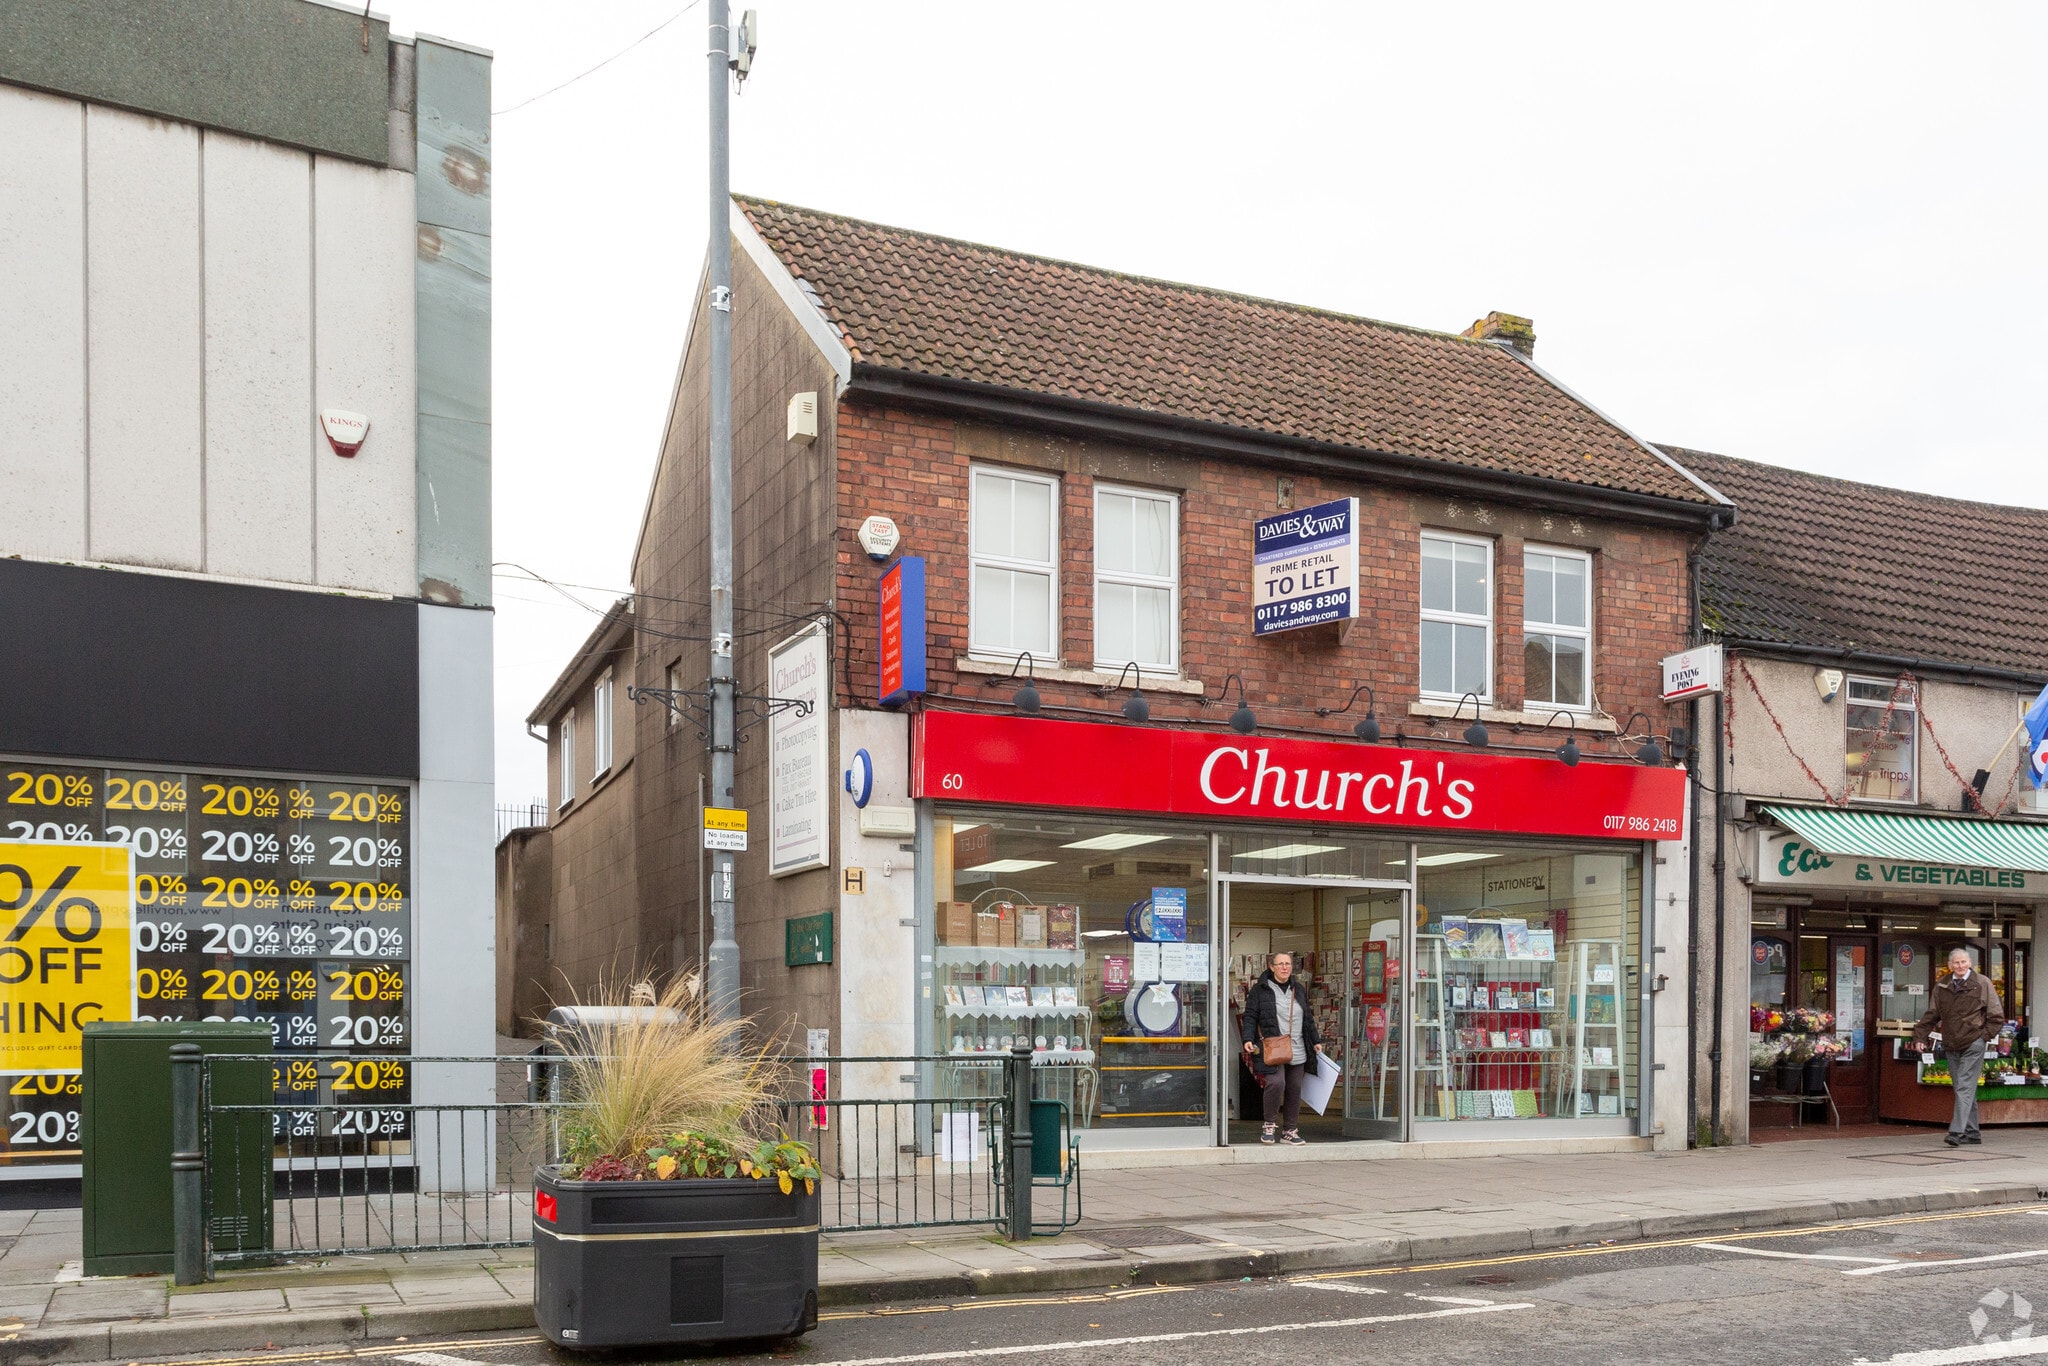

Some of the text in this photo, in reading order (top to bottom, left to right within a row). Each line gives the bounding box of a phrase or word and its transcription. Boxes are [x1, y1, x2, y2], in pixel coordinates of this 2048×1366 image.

[330, 417, 362, 427] KINGS
[1259, 538, 1346, 561] CHARTERED SURVEYORS ESTATE AGENTS
[1270, 554, 1334, 575] PRIME RETAIL
[1265, 566, 1339, 598] TO LET
[1257, 592, 1347, 620] 0117 986 8300
[1264, 610, 1338, 631] daviesandway.com
[776, 652, 817, 693] Church's
[1671, 667, 1699, 683] EVENING
[1677, 679, 1693, 690] POST
[781, 724, 817, 751] Photocopying
[781, 753, 812, 776] Fax Bureau
[1880, 768, 1908, 782] Tripps
[7, 772, 93, 807] 20% OFF
[942, 773, 963, 790] 60
[1199, 746, 1475, 819] Church's
[105, 778, 187, 812] 20% OFF
[201, 784, 279, 817] 20% OFF
[781, 789, 817, 812] Cake Tin Hire
[289, 809, 314, 819] OFF
[328, 791, 402, 823] 20% OFF
[782, 818, 812, 837] Laminating
[1603, 815, 1677, 832] 0117 986 2418
[201, 830, 279, 864] 20% OFF
[719, 833, 744, 841] loading
[160, 849, 187, 859] OFF
[289, 855, 315, 864] OFF
[329, 836, 402, 867] 20% OFF
[1488, 875, 1545, 892] STATIONERY
[1855, 863, 2025, 889] & VEGETABLES
[160, 896, 187, 906] OFF
[201, 877, 280, 909] 20% OFF
[329, 881, 402, 912] 20% OFF
[289, 900, 315, 910] OFF
[160, 943, 187, 952] OFF
[201, 923, 280, 954] 20%
[253, 945, 280, 955] OFF
[290, 945, 316, 955] OFF
[329, 926, 403, 956] 20%
[378, 947, 403, 957] OFF
[0, 946, 103, 985] OFF
[160, 990, 187, 999] OFF
[201, 969, 280, 1000] 20% OFF
[291, 991, 317, 1000] OFF
[330, 971, 403, 1001] 20% OFF
[291, 1036, 317, 1046] OFF
[330, 1015, 404, 1046] 20% OFF
[291, 1081, 317, 1091] OFF
[330, 1061, 404, 1090] 20% OFF
[380, 1124, 404, 1134] OFF
